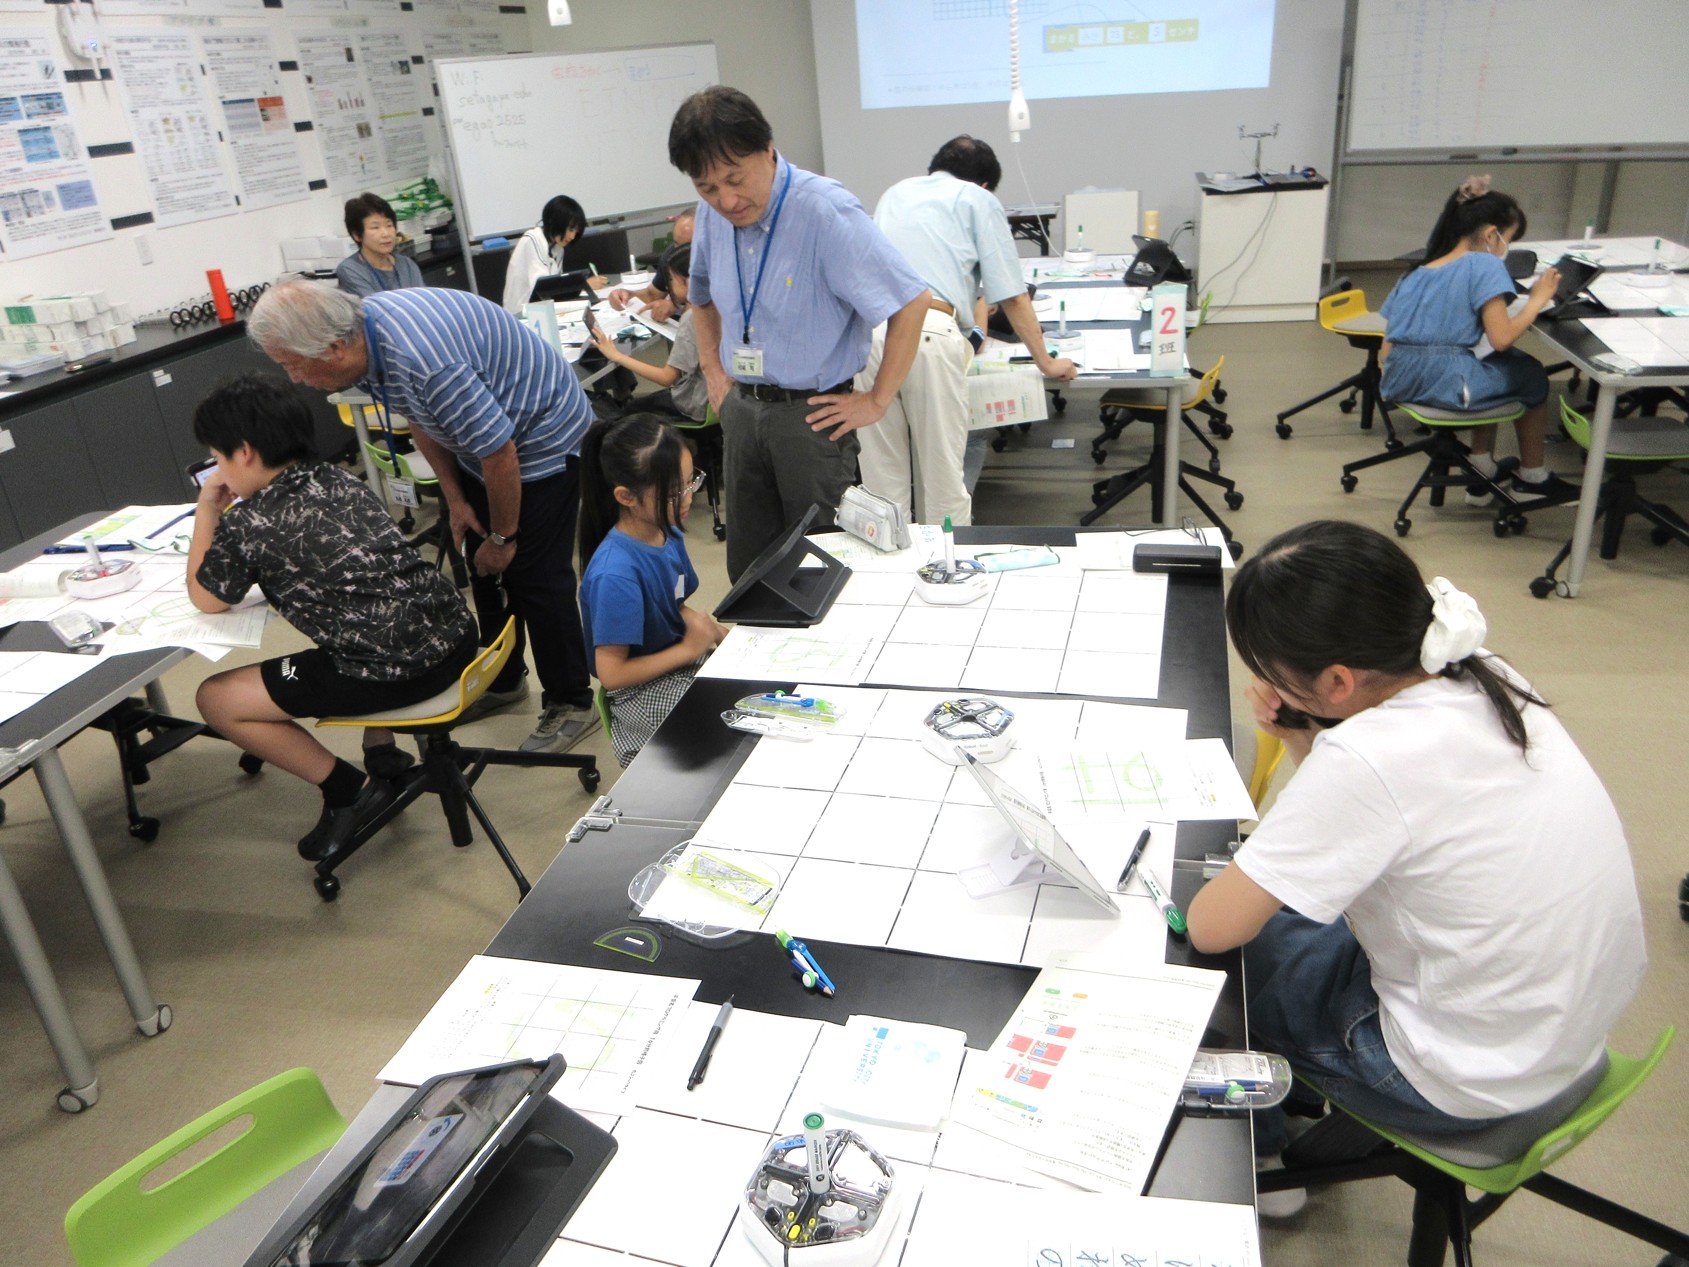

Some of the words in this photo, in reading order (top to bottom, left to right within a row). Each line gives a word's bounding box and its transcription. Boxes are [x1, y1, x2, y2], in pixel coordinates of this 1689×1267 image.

[1159, 306, 1179, 335] 2
[852, 1037, 874, 1083] UNIVERSITY
[869, 1040, 885, 1066] TOKYO
[861, 1070, 873, 1086] CITY
